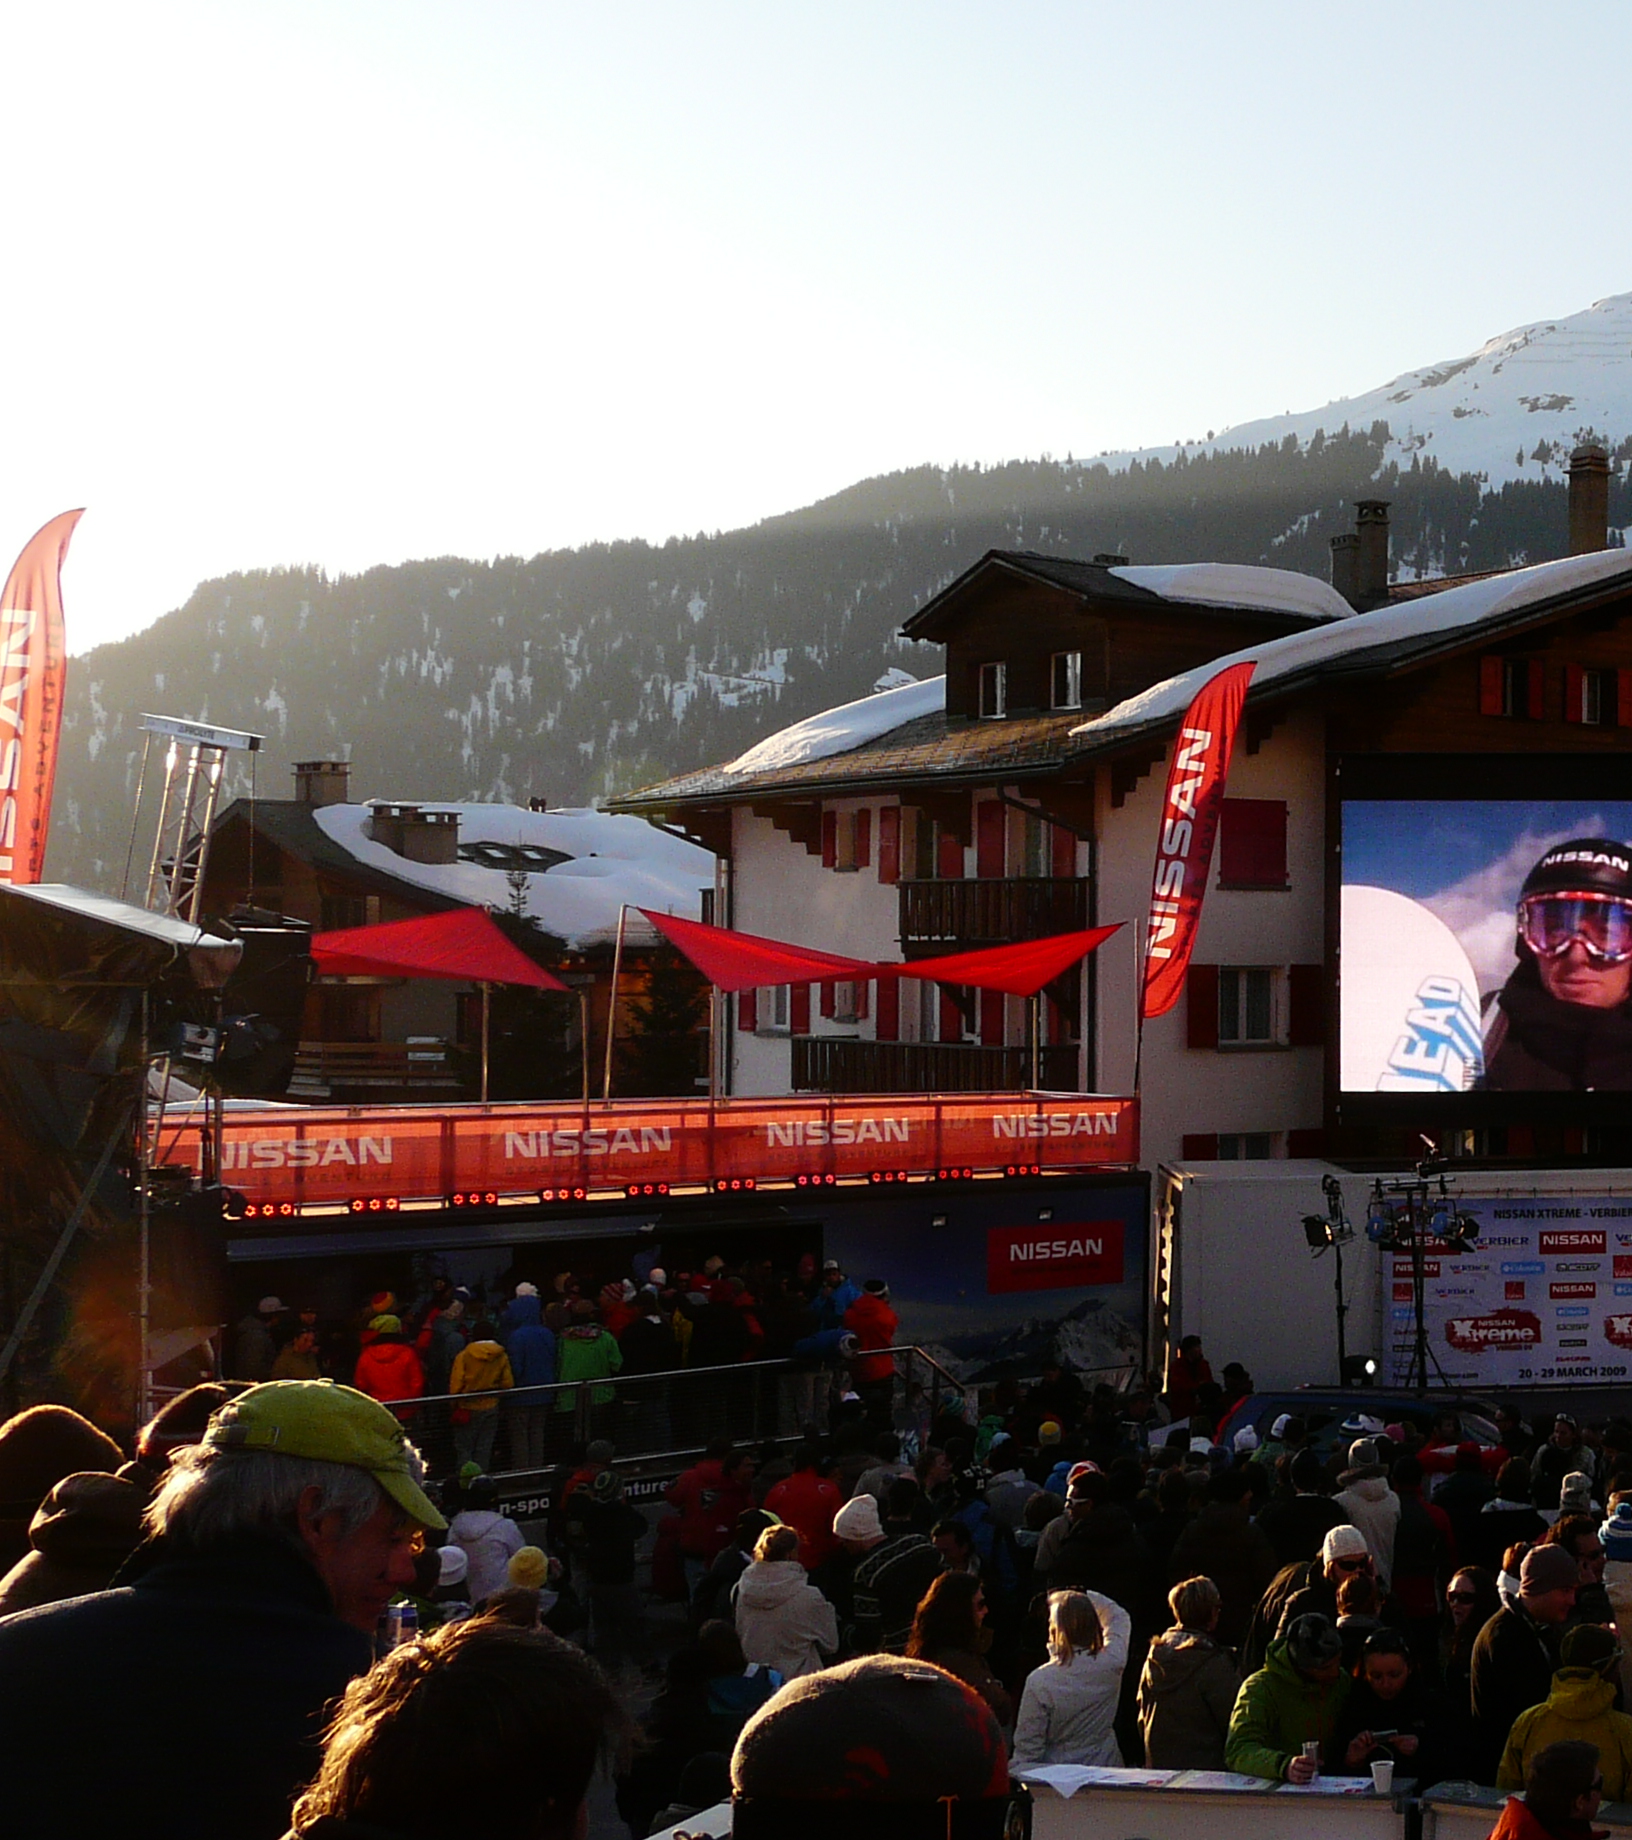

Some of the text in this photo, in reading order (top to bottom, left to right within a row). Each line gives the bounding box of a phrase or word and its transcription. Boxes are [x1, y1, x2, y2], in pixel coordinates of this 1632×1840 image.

[0, 608, 37, 884] ISSAN
[1147, 727, 1212, 960] NISSAN
[1541, 851, 1629, 872] NISSAN
[767, 1117, 909, 1147] NISSAN
[993, 1112, 1118, 1138] NISSAN
[505, 1126, 672, 1159] NISSAN
[1494, 1208, 1535, 1219] NISSAN
[1537, 1208, 1581, 1219] XTREME
[1009, 1237, 1103, 1262] NISSAN
[1472, 1237, 1529, 1246] VERBIER
[1543, 1234, 1603, 1246] NISSAN
[1394, 1264, 1438, 1272] NISAN
[1552, 1285, 1594, 1294] NISSAN
[1451, 1319, 1536, 1343] Xtreme
[1477, 1319, 1516, 1327] NISSAN
[1519, 1368, 1532, 1379] 20
[1542, 1367, 1554, 1378] 29
[1556, 1366, 1597, 1377] MARCH
[1600, 1366, 1627, 1376] 2009
